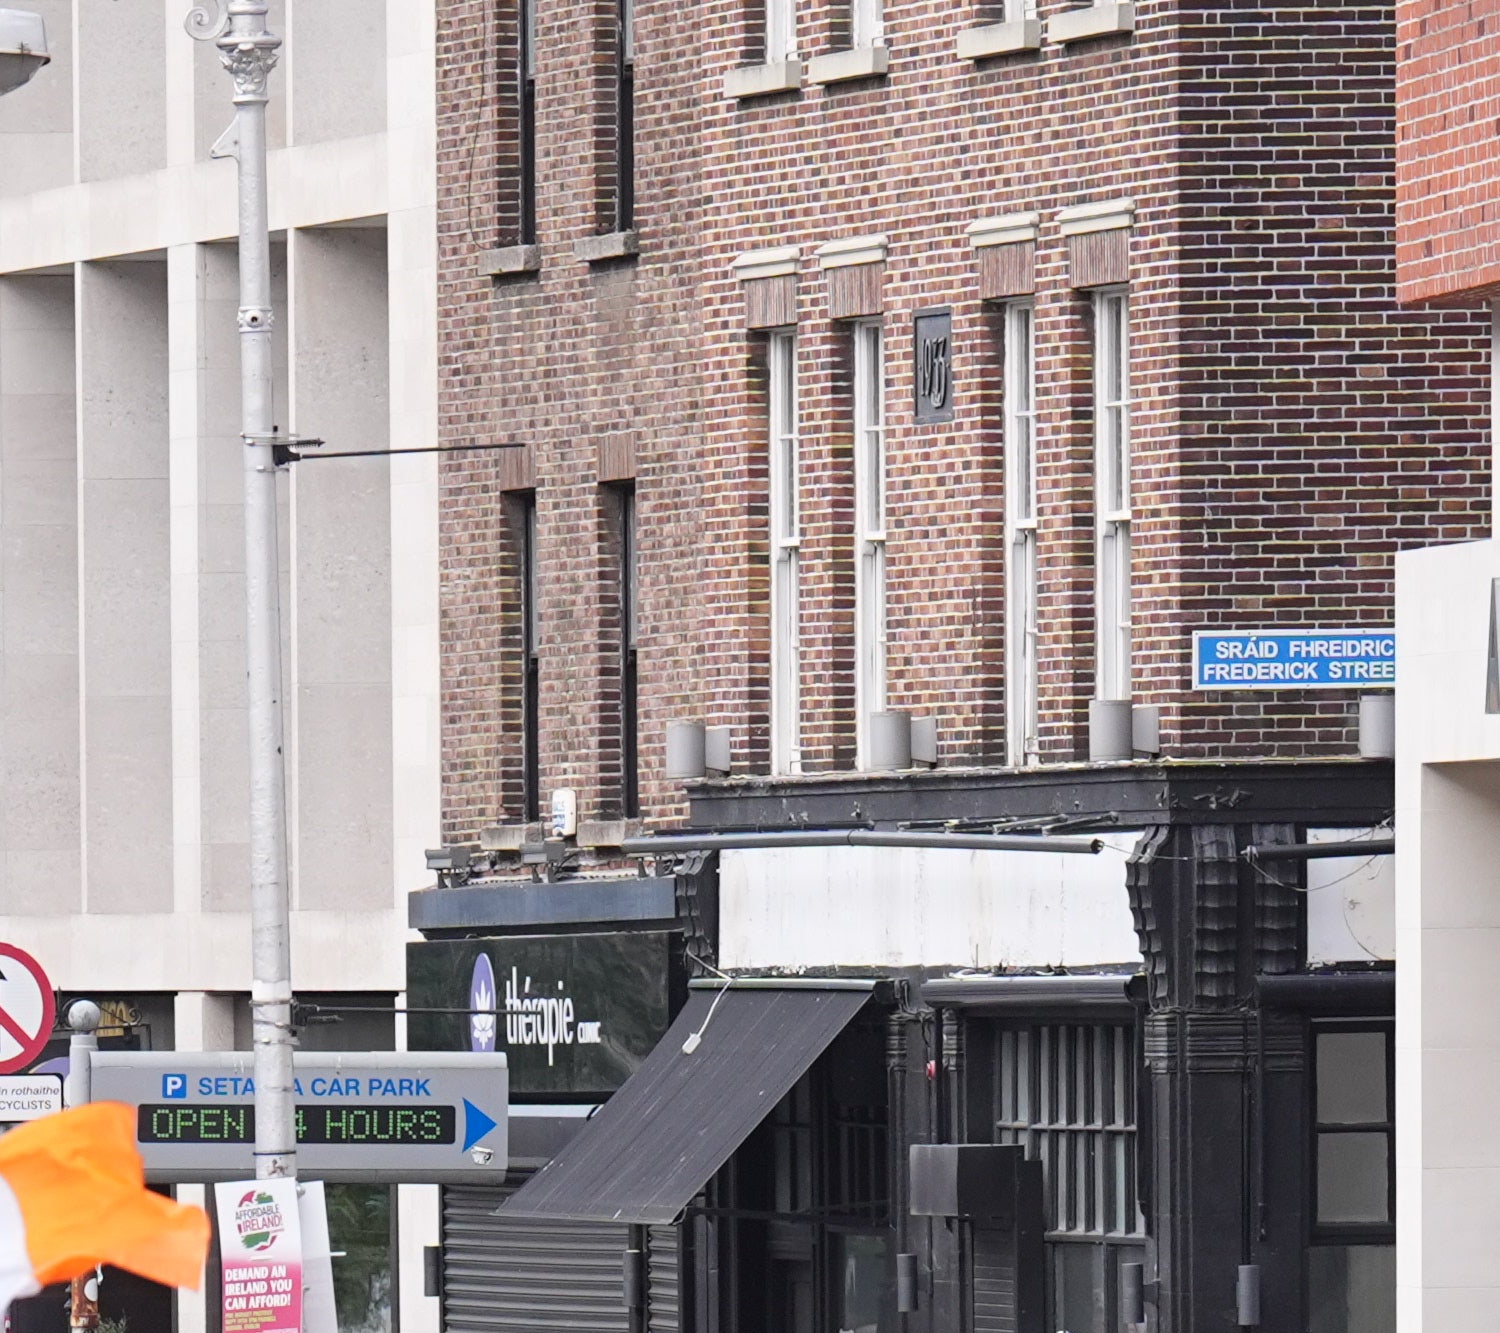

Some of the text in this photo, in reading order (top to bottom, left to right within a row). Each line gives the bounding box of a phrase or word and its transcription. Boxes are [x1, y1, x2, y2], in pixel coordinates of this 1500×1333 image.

[1216, 637, 1394, 658] SRÁID FHREIDRIC
[1203, 662, 1318, 681] FREDERICK
[505, 966, 574, 1066] thérapie
[11, 1086, 60, 1096] rothaithe
[198, 1078, 303, 1096] SETAA
[310, 1079, 360, 1096] CAR
[369, 1078, 431, 1096] PARK
[153, 1109, 441, 1139] OPEN HOURS
[235, 1203, 280, 1221] AFFORDABLE
[242, 1216, 283, 1233] IRELAND!
[224, 1264, 286, 1282] DEMAND AN
[225, 1279, 293, 1296] IRELAND YOU
[225, 1294, 291, 1311] CAN AFFORD!
